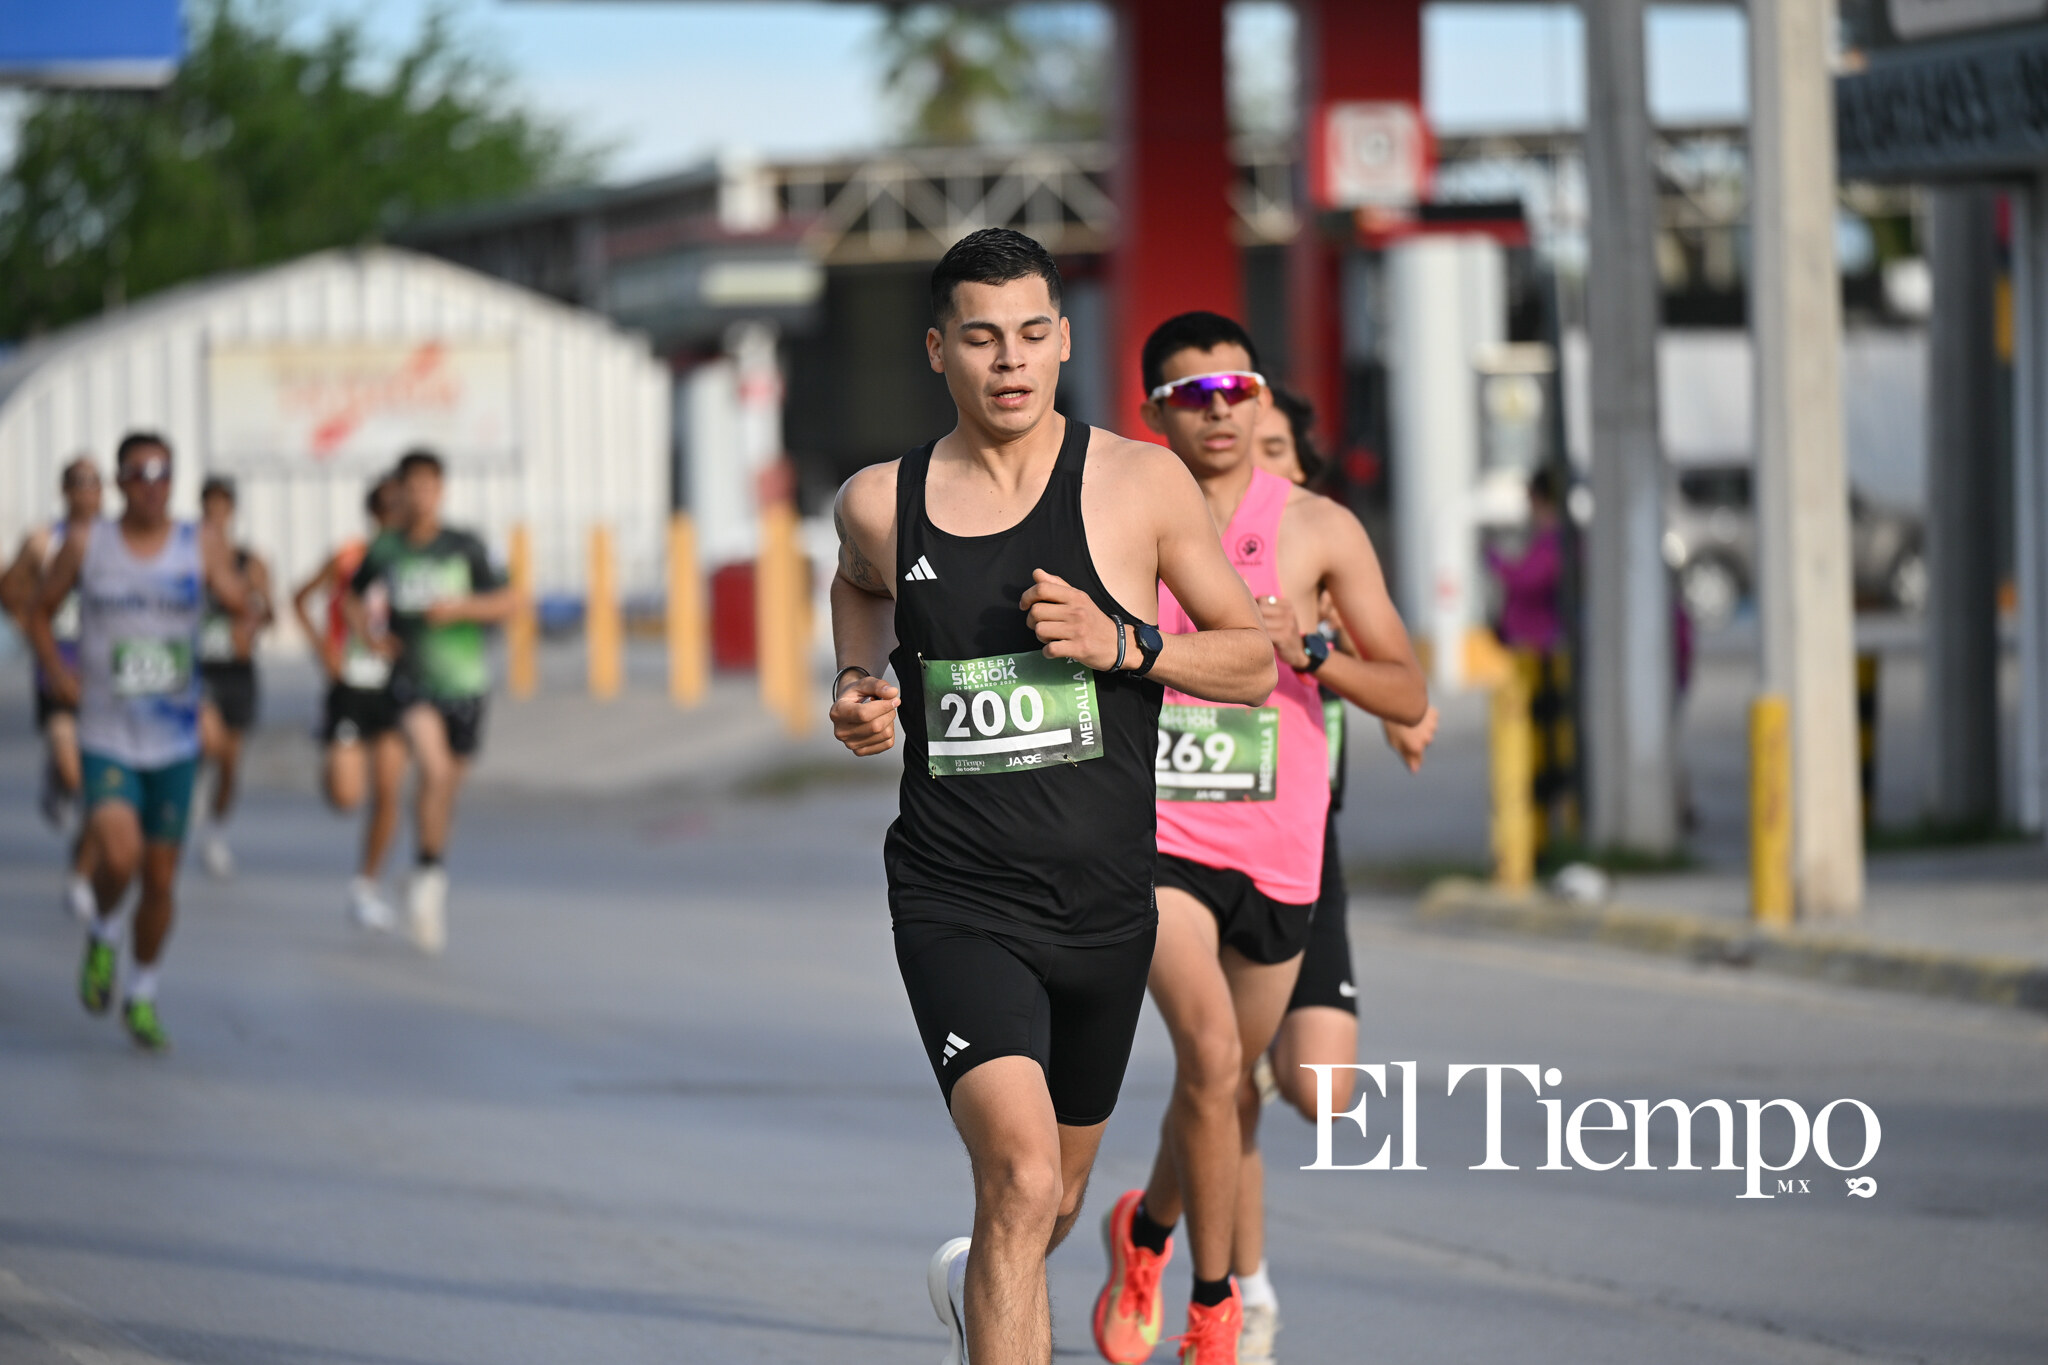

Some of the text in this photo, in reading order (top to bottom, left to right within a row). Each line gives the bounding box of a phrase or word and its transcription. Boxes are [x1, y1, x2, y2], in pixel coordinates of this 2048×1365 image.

[951, 657, 1016, 672] CARRERA
[974, 681, 998, 689] MARZO
[940, 685, 1044, 738] 200
[1072, 670, 1095, 746] MEDALLA
[1155, 728, 1235, 772] 269
